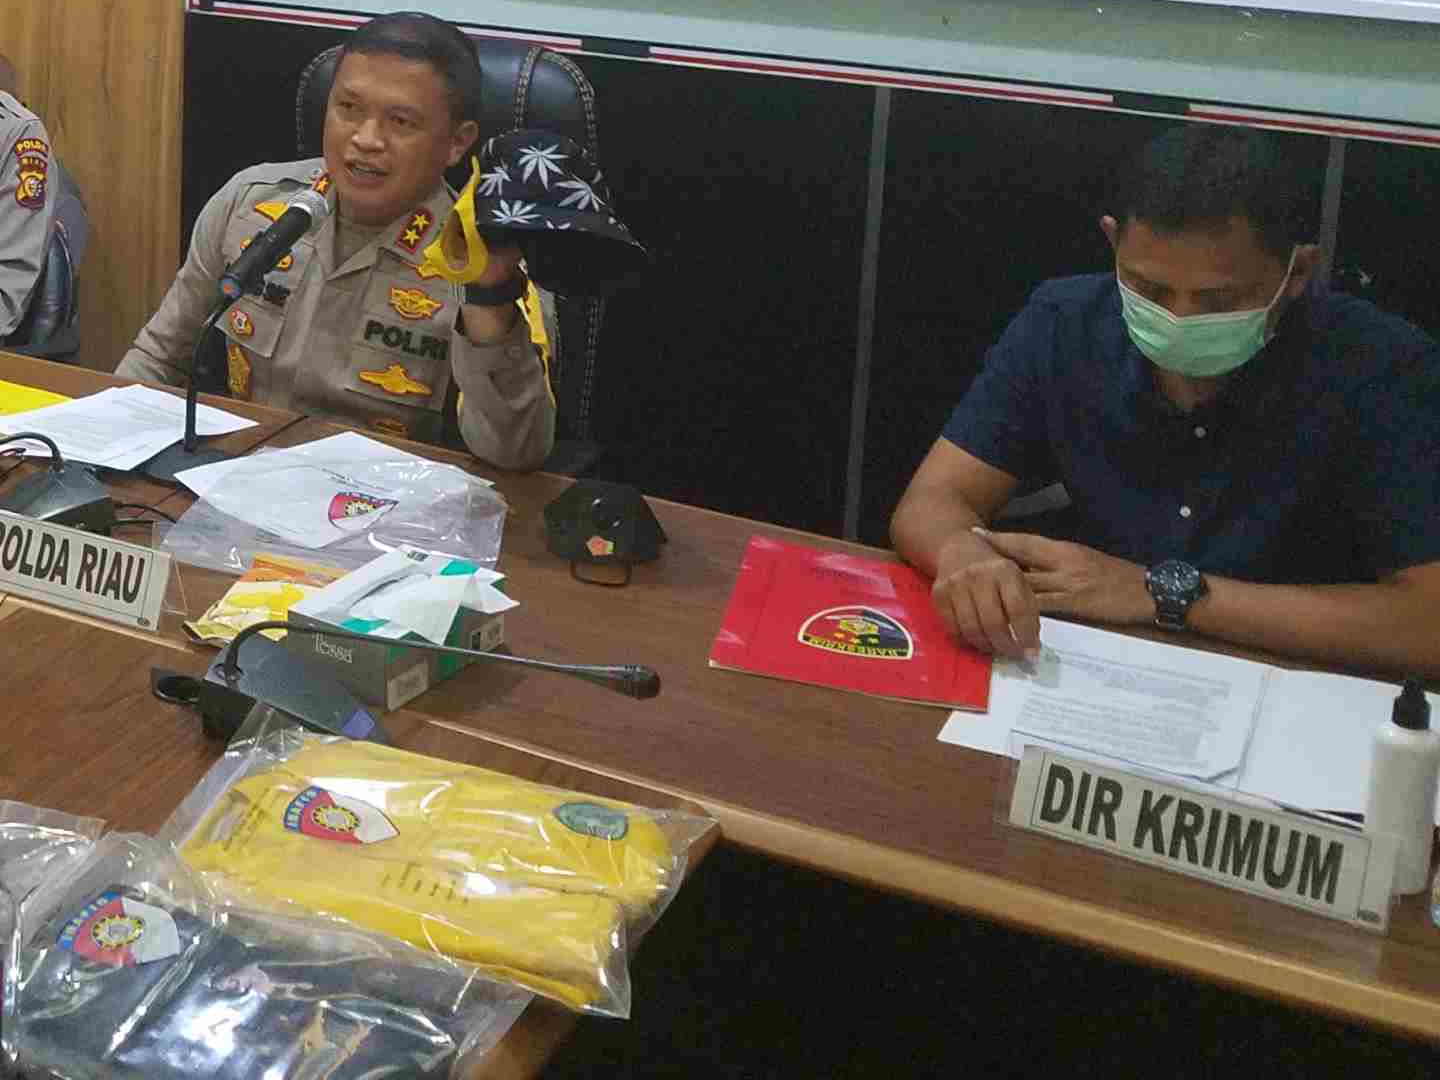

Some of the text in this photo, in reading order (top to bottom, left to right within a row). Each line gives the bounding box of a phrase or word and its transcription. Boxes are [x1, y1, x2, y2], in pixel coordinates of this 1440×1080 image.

[364, 320, 448, 360] POLRI
[76, 543, 144, 604] RIAU
[1039, 762, 1344, 905] DIR KRIMUM
